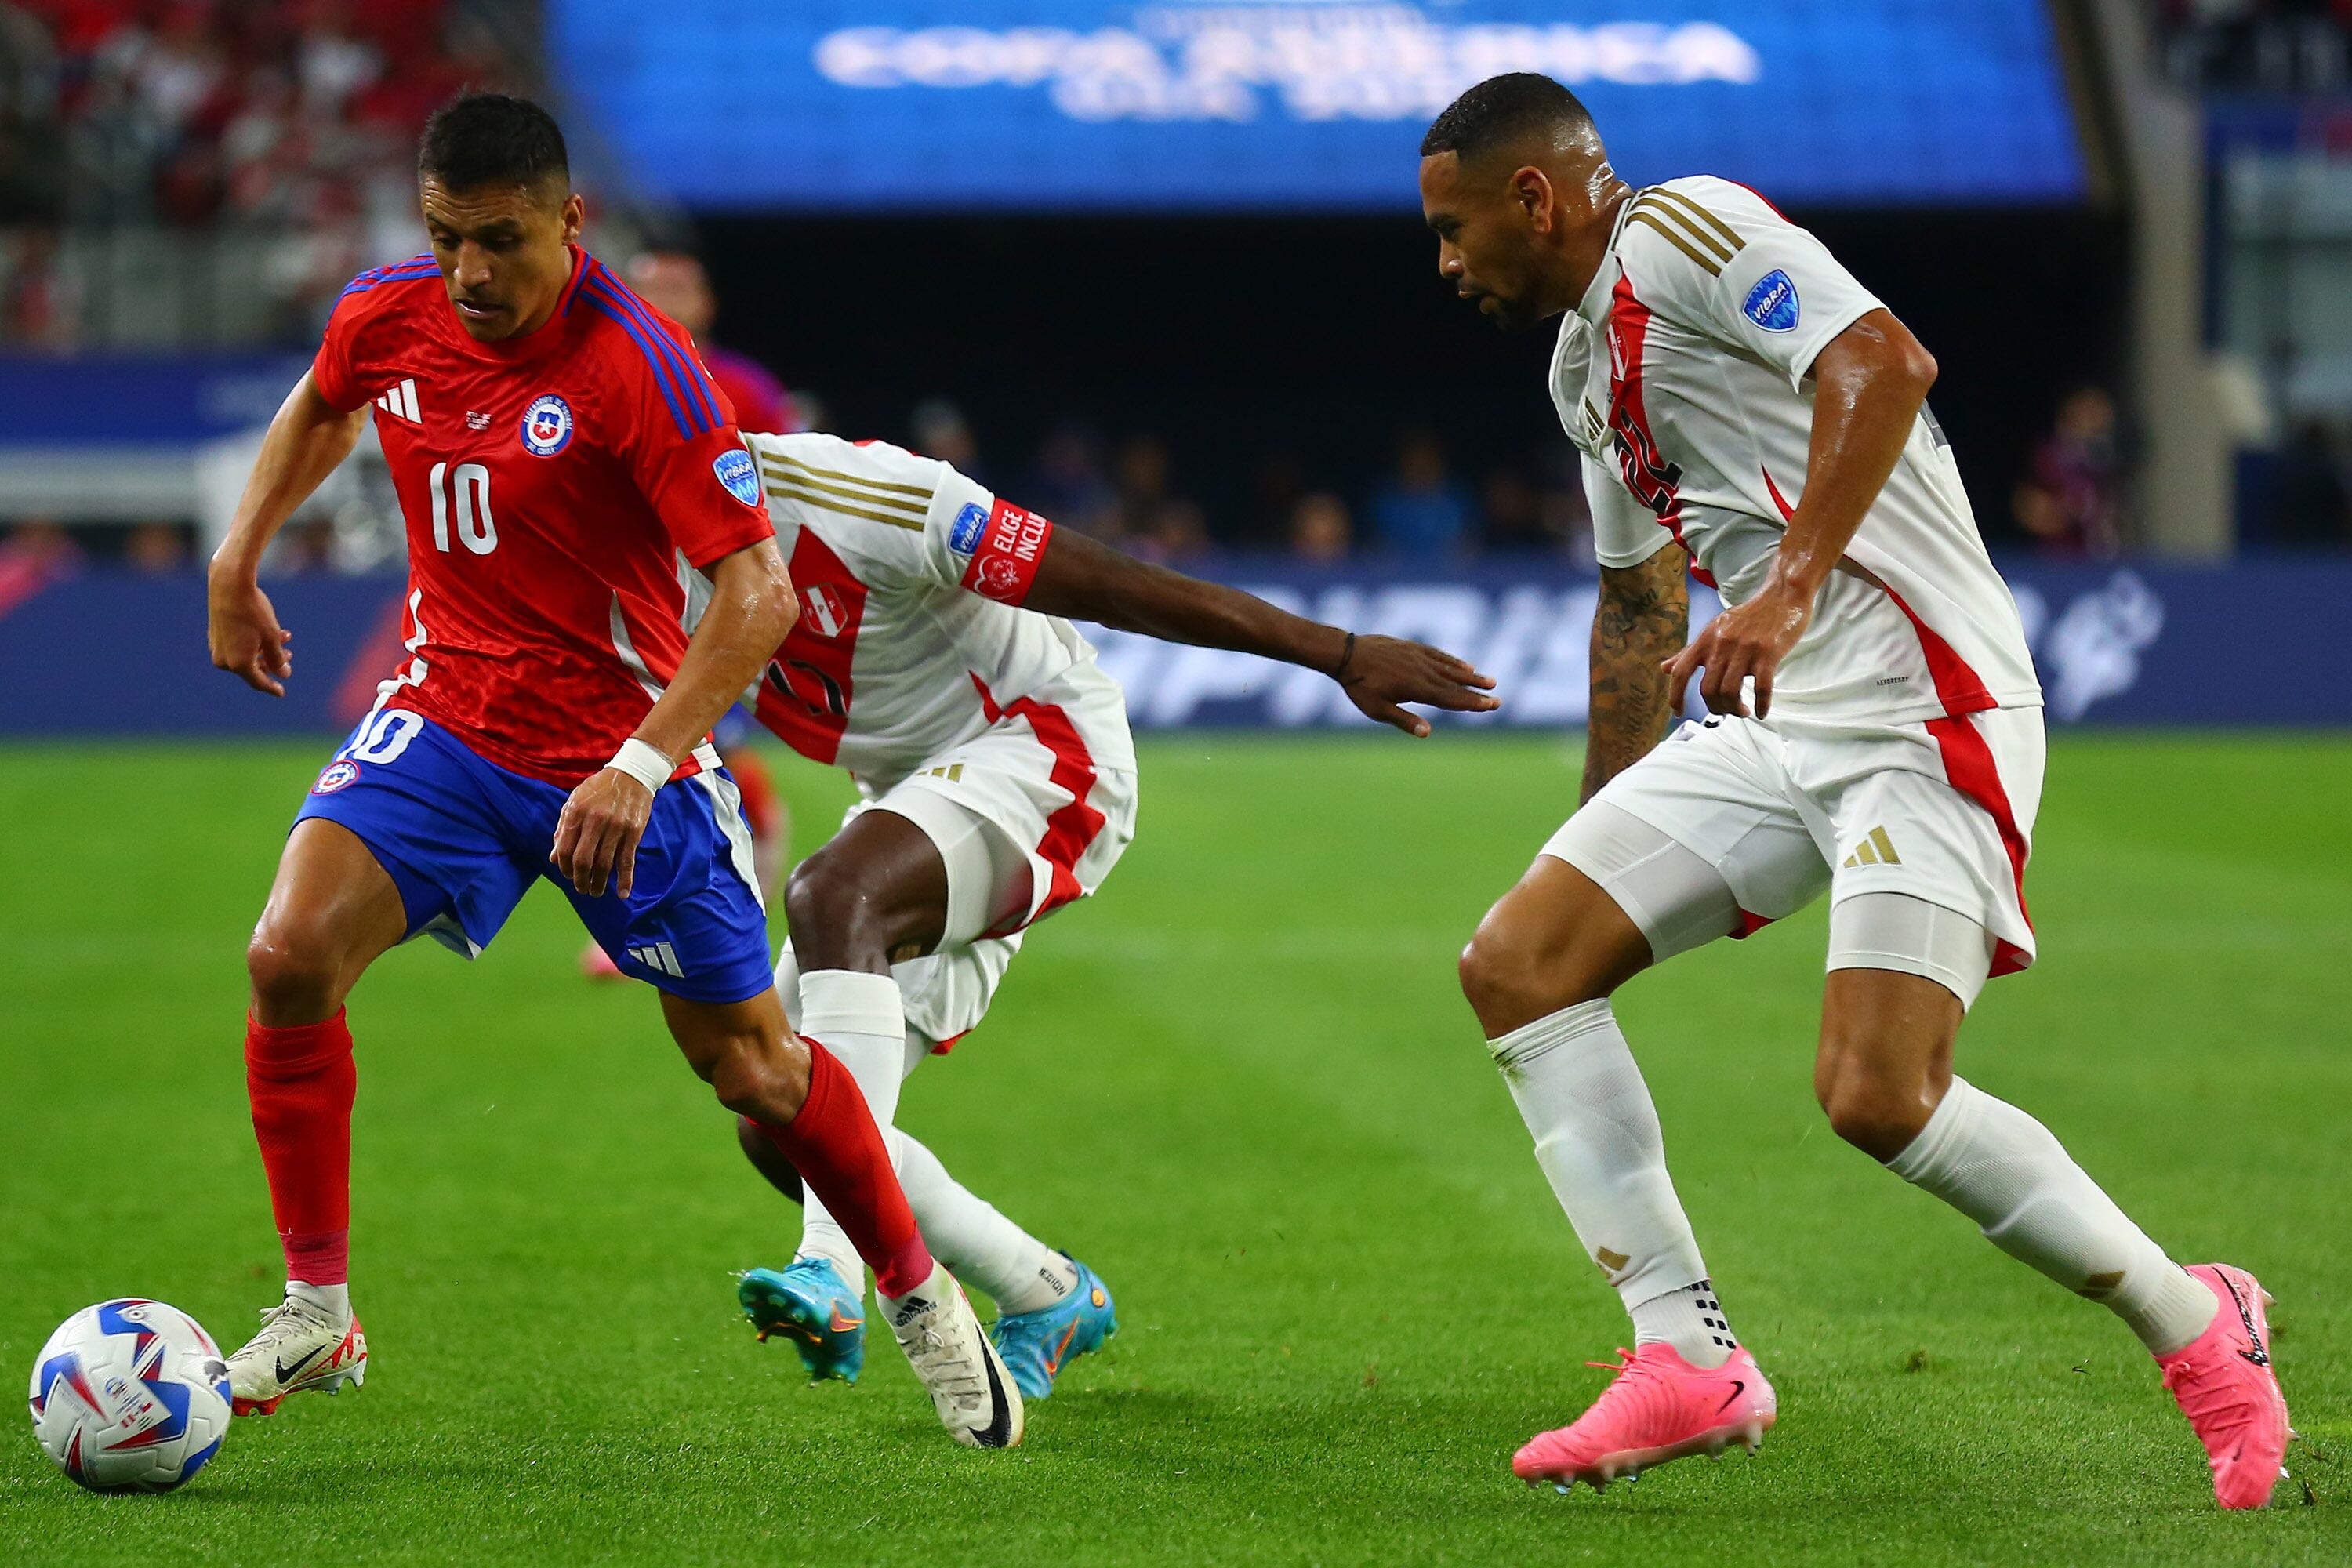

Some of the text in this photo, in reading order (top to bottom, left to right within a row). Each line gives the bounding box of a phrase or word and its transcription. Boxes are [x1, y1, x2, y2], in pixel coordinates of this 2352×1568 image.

[1754, 282, 1787, 320] VIBRA
[723, 461, 751, 481] VIBRA
[430, 462, 498, 555] 10
[959, 512, 983, 550] VIBRA
[993, 509, 1023, 553] ELIGE
[336, 709, 425, 765] 10
